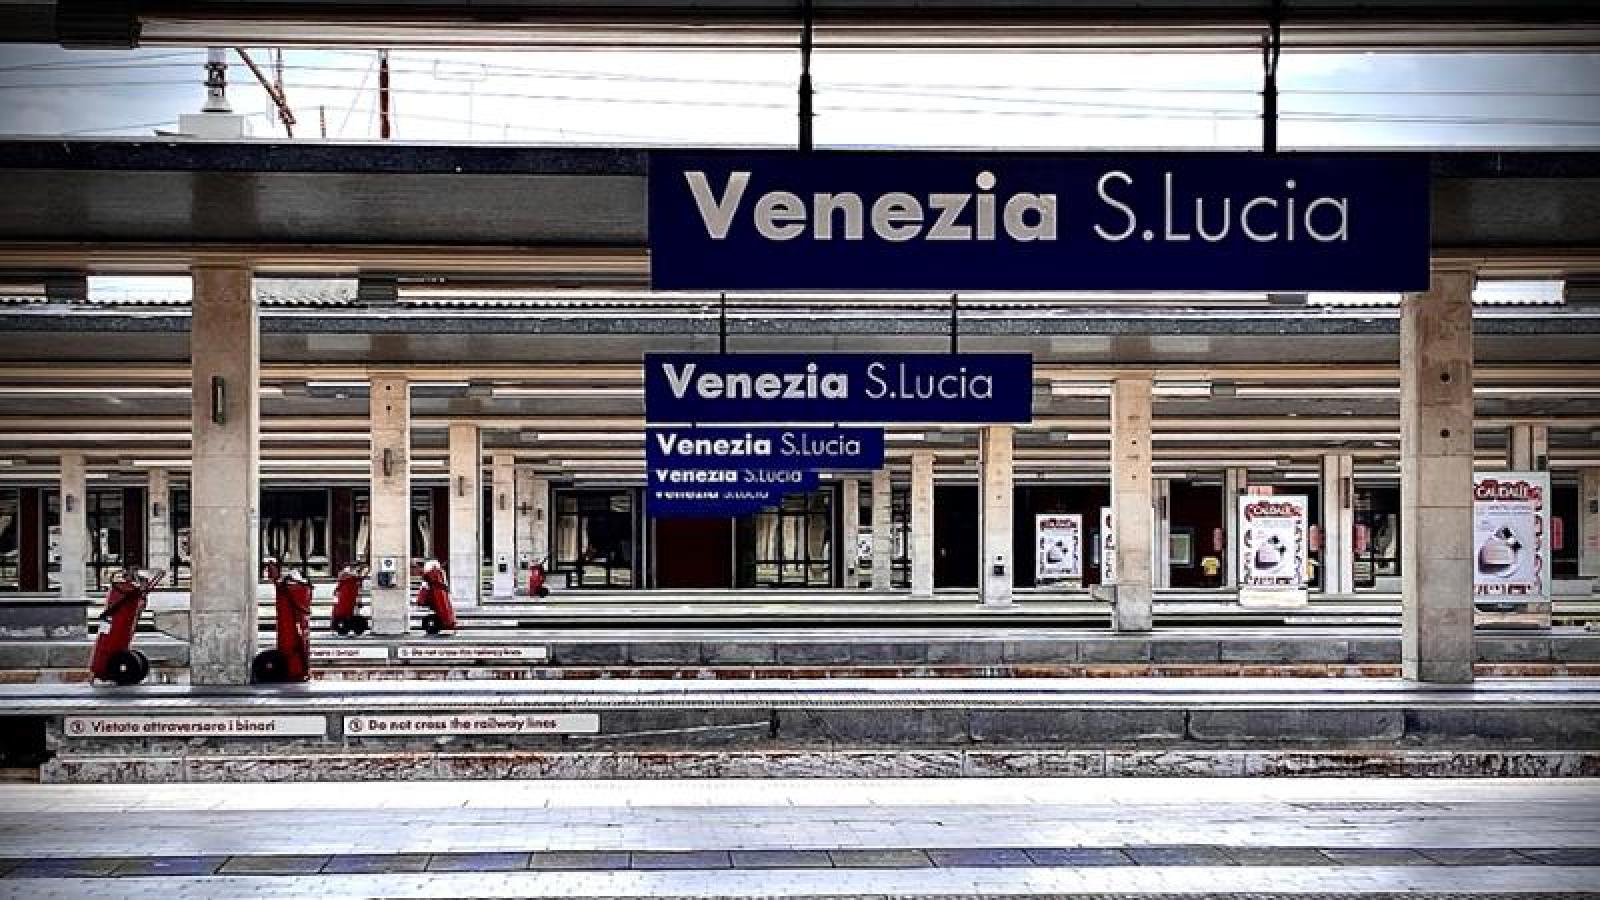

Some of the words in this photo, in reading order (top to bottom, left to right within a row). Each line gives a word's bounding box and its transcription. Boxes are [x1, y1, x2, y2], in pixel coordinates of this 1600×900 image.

[684, 170, 1057, 243] Venezia
[1093, 170, 1350, 243] S.Lucia
[662, 362, 849, 399] Venezia
[865, 361, 993, 399] S.Lucia
[655, 432, 771, 456] Venezia
[780, 431, 861, 457] S.Lucia
[655, 469, 738, 483] Venezia
[91, 719, 140, 733] Vietato
[229, 719, 234, 732] i
[235, 719, 275, 732] binari
[368, 718, 388, 731] Do
[389, 718, 412, 731] not
[415, 720, 447, 730] cross
[449, 717, 471, 730] the
[473, 717, 525, 731] railway
[526, 717, 558, 730] lines
